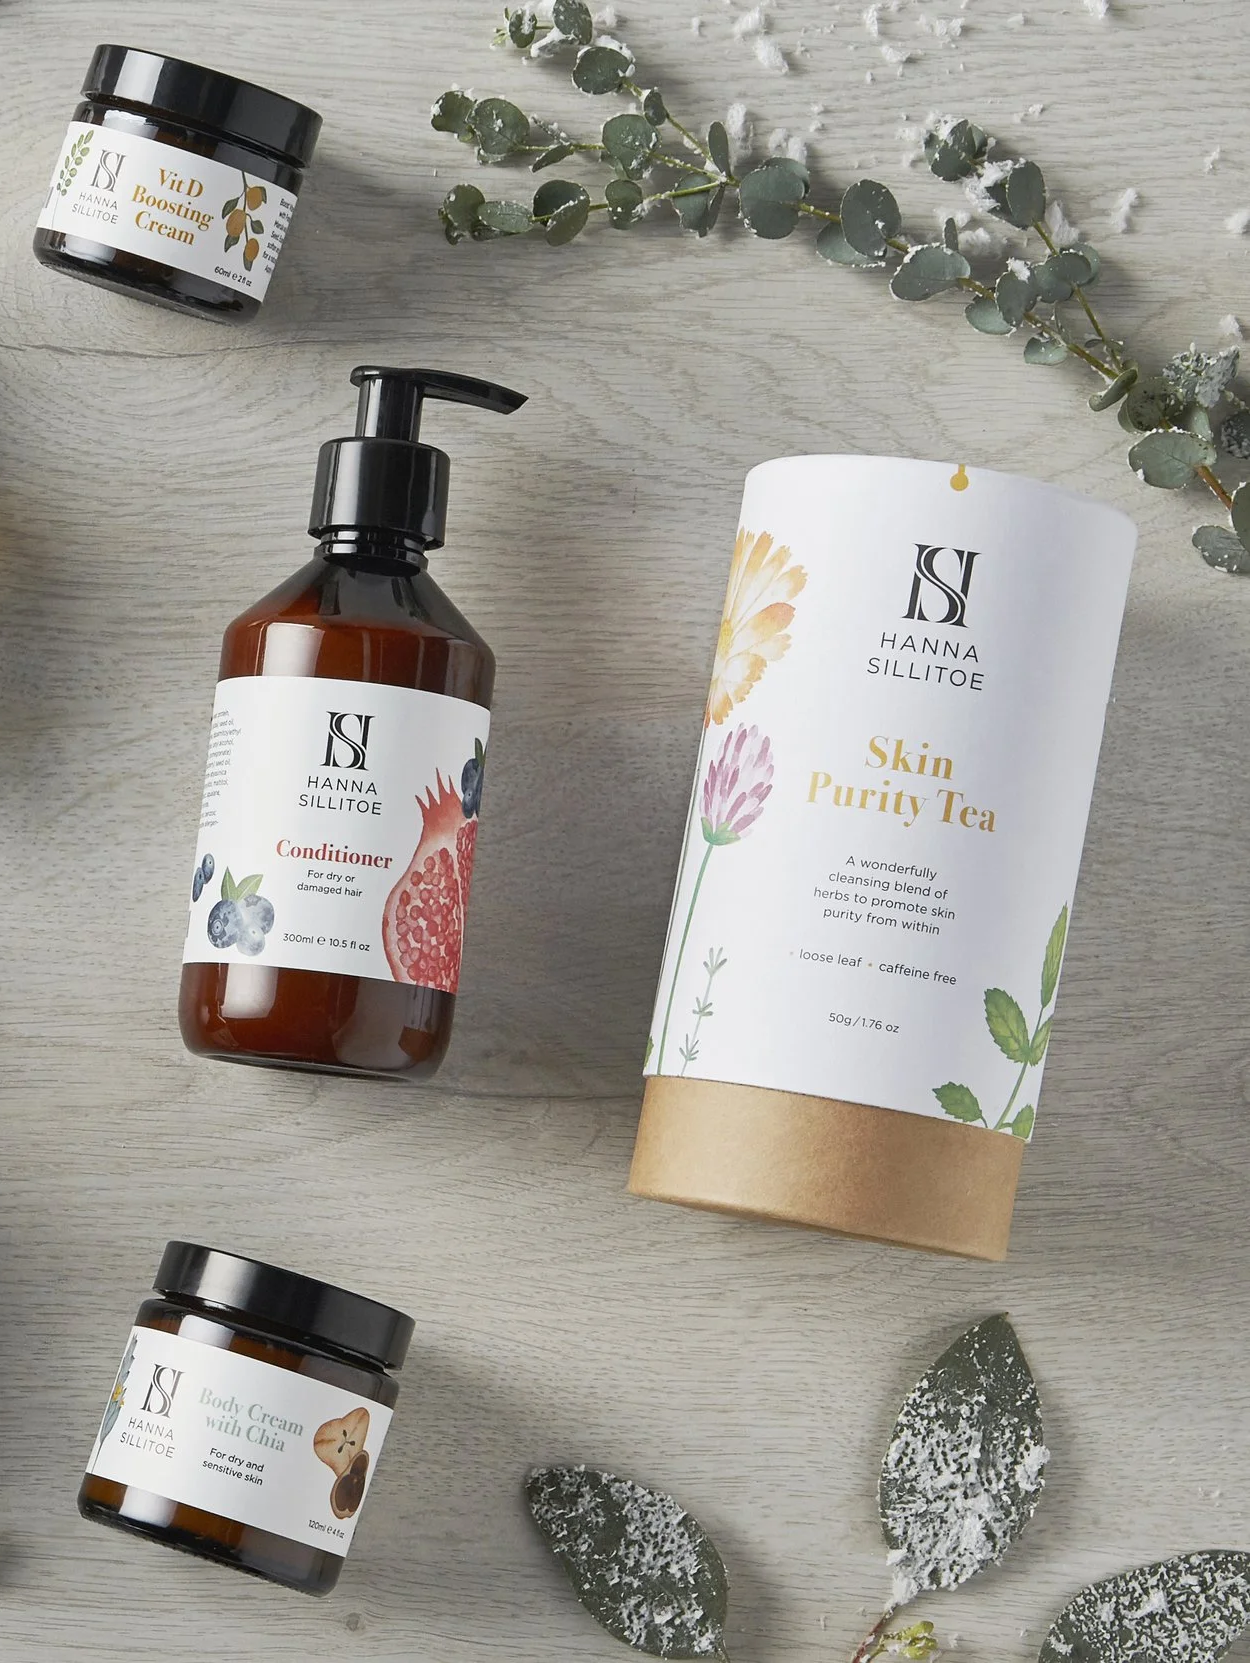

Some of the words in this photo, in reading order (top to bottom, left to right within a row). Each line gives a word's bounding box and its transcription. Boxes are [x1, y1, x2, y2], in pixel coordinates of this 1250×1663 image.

[158, 168, 185, 193] Vit
[186, 178, 204, 198] D
[72, 203, 119, 225] SILLITOE
[79, 192, 118, 210] HANNA
[131, 183, 214, 231] Boosting
[135, 210, 195, 246] Cream
[214, 266, 231, 278] 60ml
[880, 631, 980, 663] HANNA
[867, 657, 985, 691] SILLITOE
[864, 735, 954, 781] Skin
[307, 775, 378, 796] HANNA
[298, 794, 383, 816] SILLITOE
[806, 770, 929, 828] Purity
[936, 788, 997, 833] Tea
[276, 838, 393, 869] Conditioner
[307, 869, 325, 880] For
[326, 871, 343, 884] dry
[344, 875, 356, 883] or
[845, 855, 856, 867] A
[859, 858, 938, 882] wonderfully
[297, 882, 341, 898] damaged
[343, 887, 363, 898] hair
[828, 870, 891, 894] cleansing
[893, 879, 932, 898] blend
[934, 886, 949, 901] of
[813, 886, 851, 903] herbs
[853, 892, 868, 905] to
[870, 895, 929, 917] promote
[931, 906, 956, 921] skin
[823, 906, 863, 926] purity
[865, 911, 898, 929] from
[900, 918, 941, 936] within
[283, 933, 314, 945] 300ml
[329, 937, 349, 949] 10.5
[350, 940, 357, 950] fl
[358, 943, 370, 952] oz
[799, 948, 834, 965] loose
[837, 953, 863, 970] leaf
[878, 960, 930, 981] caffeine
[933, 968, 957, 986] free
[885, 1023, 900, 1034] oz
[198, 1387, 244, 1418] Body
[247, 1403, 304, 1438] Cream
[127, 1416, 174, 1441] HANNA
[205, 1413, 243, 1440] with
[246, 1424, 287, 1453] Chia
[120, 1431, 175, 1459] SILLITOE
[202, 1458, 243, 1480] sensitive
[244, 1472, 264, 1487] skin
[209, 1447, 226, 1461] For
[227, 1452, 245, 1468] dry
[246, 1459, 265, 1473] and
[308, 1519, 326, 1532] 120ml
